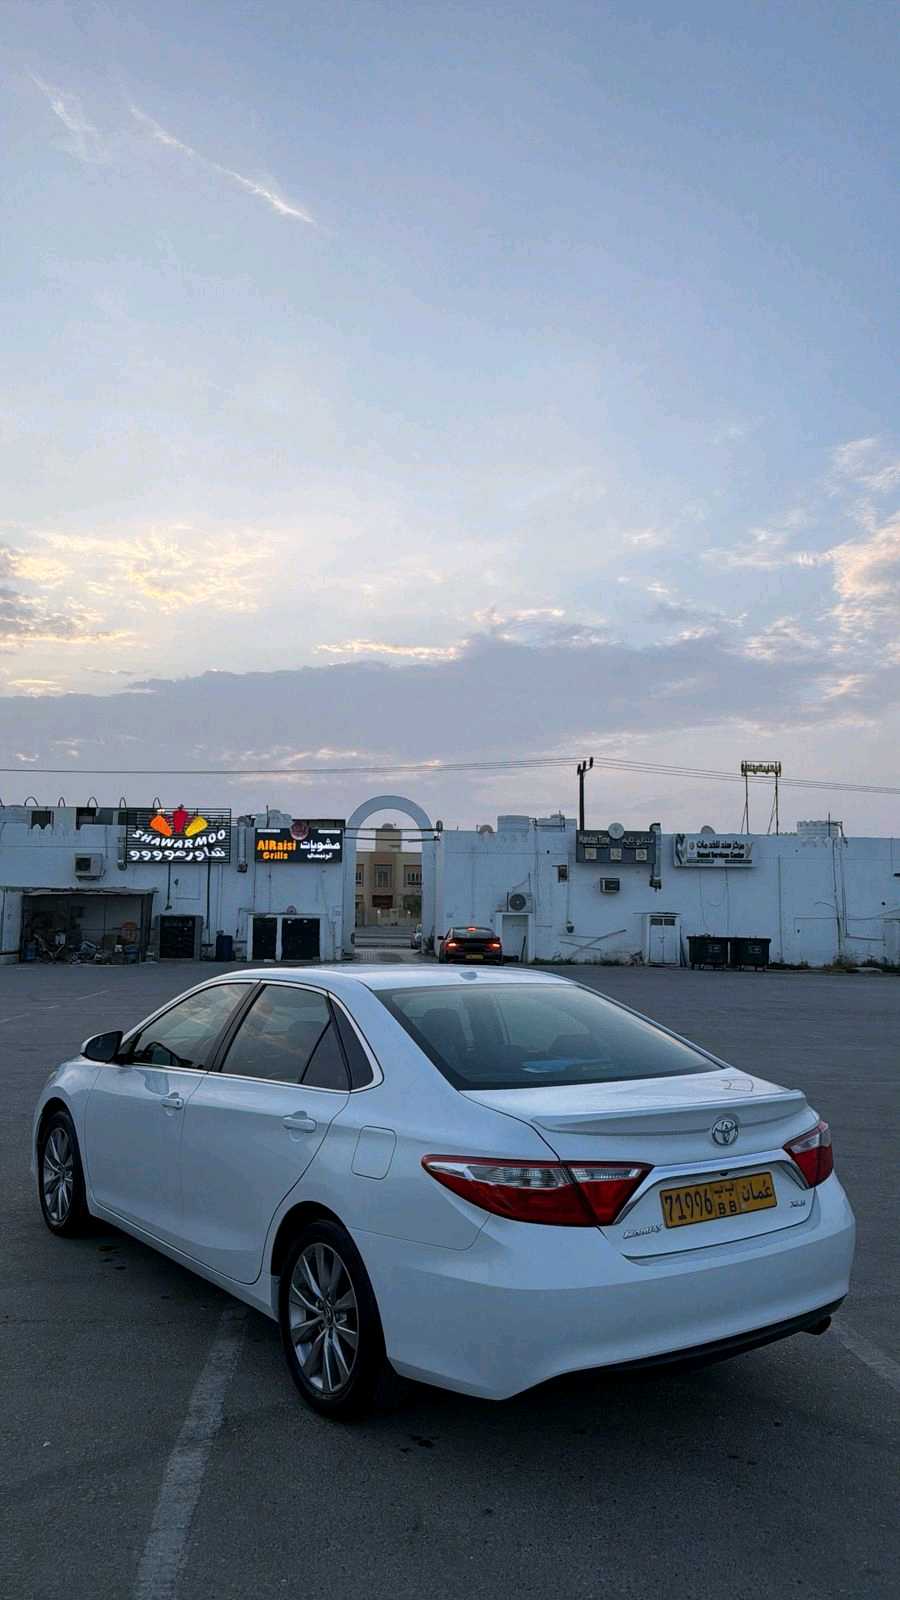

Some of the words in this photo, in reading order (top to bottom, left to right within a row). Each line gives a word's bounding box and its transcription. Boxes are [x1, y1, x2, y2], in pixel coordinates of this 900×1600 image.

[132, 829, 226, 848] SHAWARMOO
[257, 839, 297, 851] AlRaisi
[300, 838, 341, 852] مشويات
[732, 840, 745, 850] مركز
[262, 852, 289, 860] Grills
[664, 1189, 713, 1222] 71996
